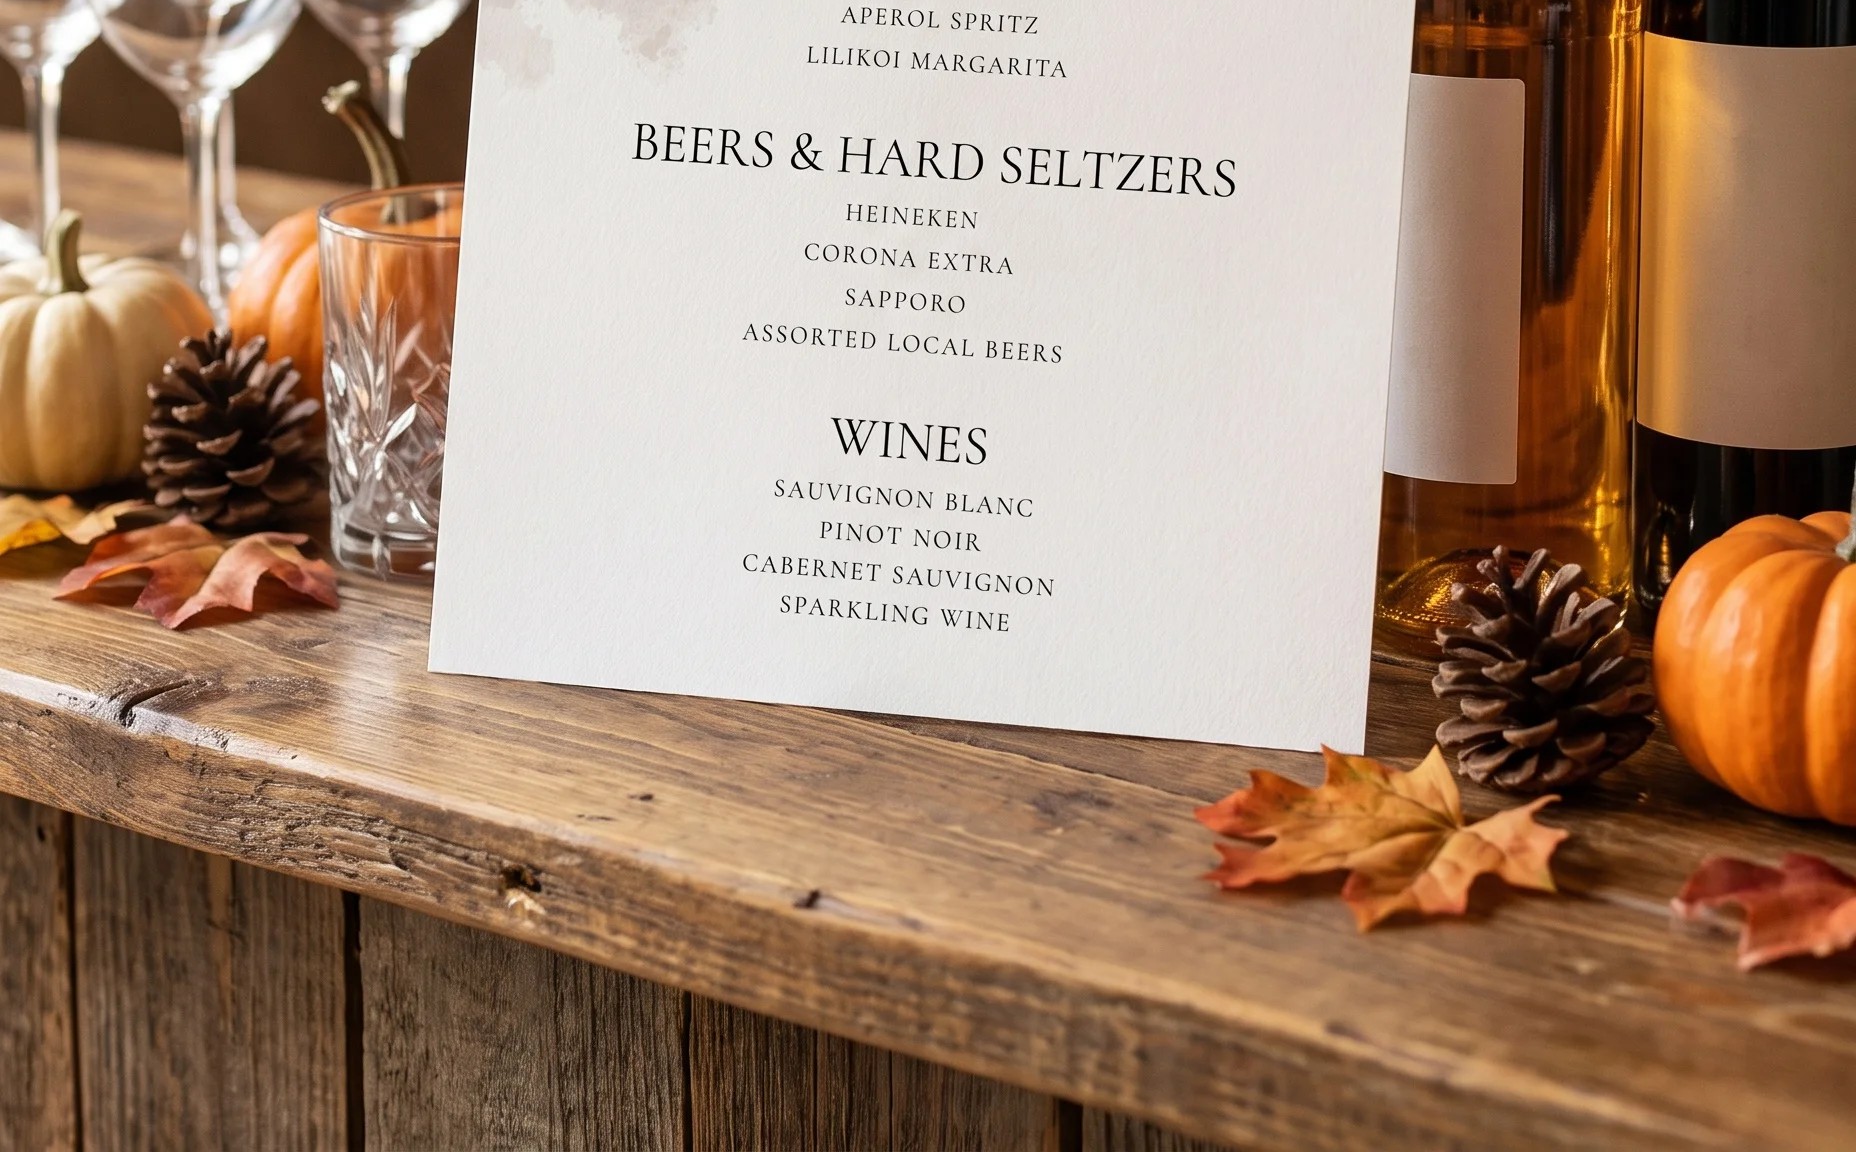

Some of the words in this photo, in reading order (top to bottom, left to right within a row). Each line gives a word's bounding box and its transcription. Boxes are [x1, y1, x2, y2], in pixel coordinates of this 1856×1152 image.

[840, 6, 940, 29] APEROL
[950, 11, 1039, 35] SPRITZ
[806, 45, 900, 69] LILIKOI
[910, 51, 1067, 79] MARGARITA
[631, 122, 773, 169] BEERS
[790, 132, 825, 172] &
[837, 135, 984, 181] HARD
[1000, 145, 1236, 198] SELTZERS
[845, 203, 979, 230] HEINEKEN
[804, 242, 917, 268] CORONA
[928, 251, 1014, 275] EXTRA
[844, 287, 966, 314] SAPPORO
[742, 323, 877, 350] ASSORTED
[887, 333, 975, 358] LOCAL
[985, 340, 1062, 364] BEERS
[830, 416, 987, 466] WINES
[773, 478, 934, 510] SAUVIGNON
[944, 492, 1033, 518] BLANC
[819, 520, 903, 545] PINOT
[912, 528, 981, 552] NOIR
[742, 553, 882, 582] CABERNET
[892, 565, 1055, 597] SAUVIGNON
[779, 594, 929, 626] SPARKLING
[940, 608, 1009, 632] WINE
